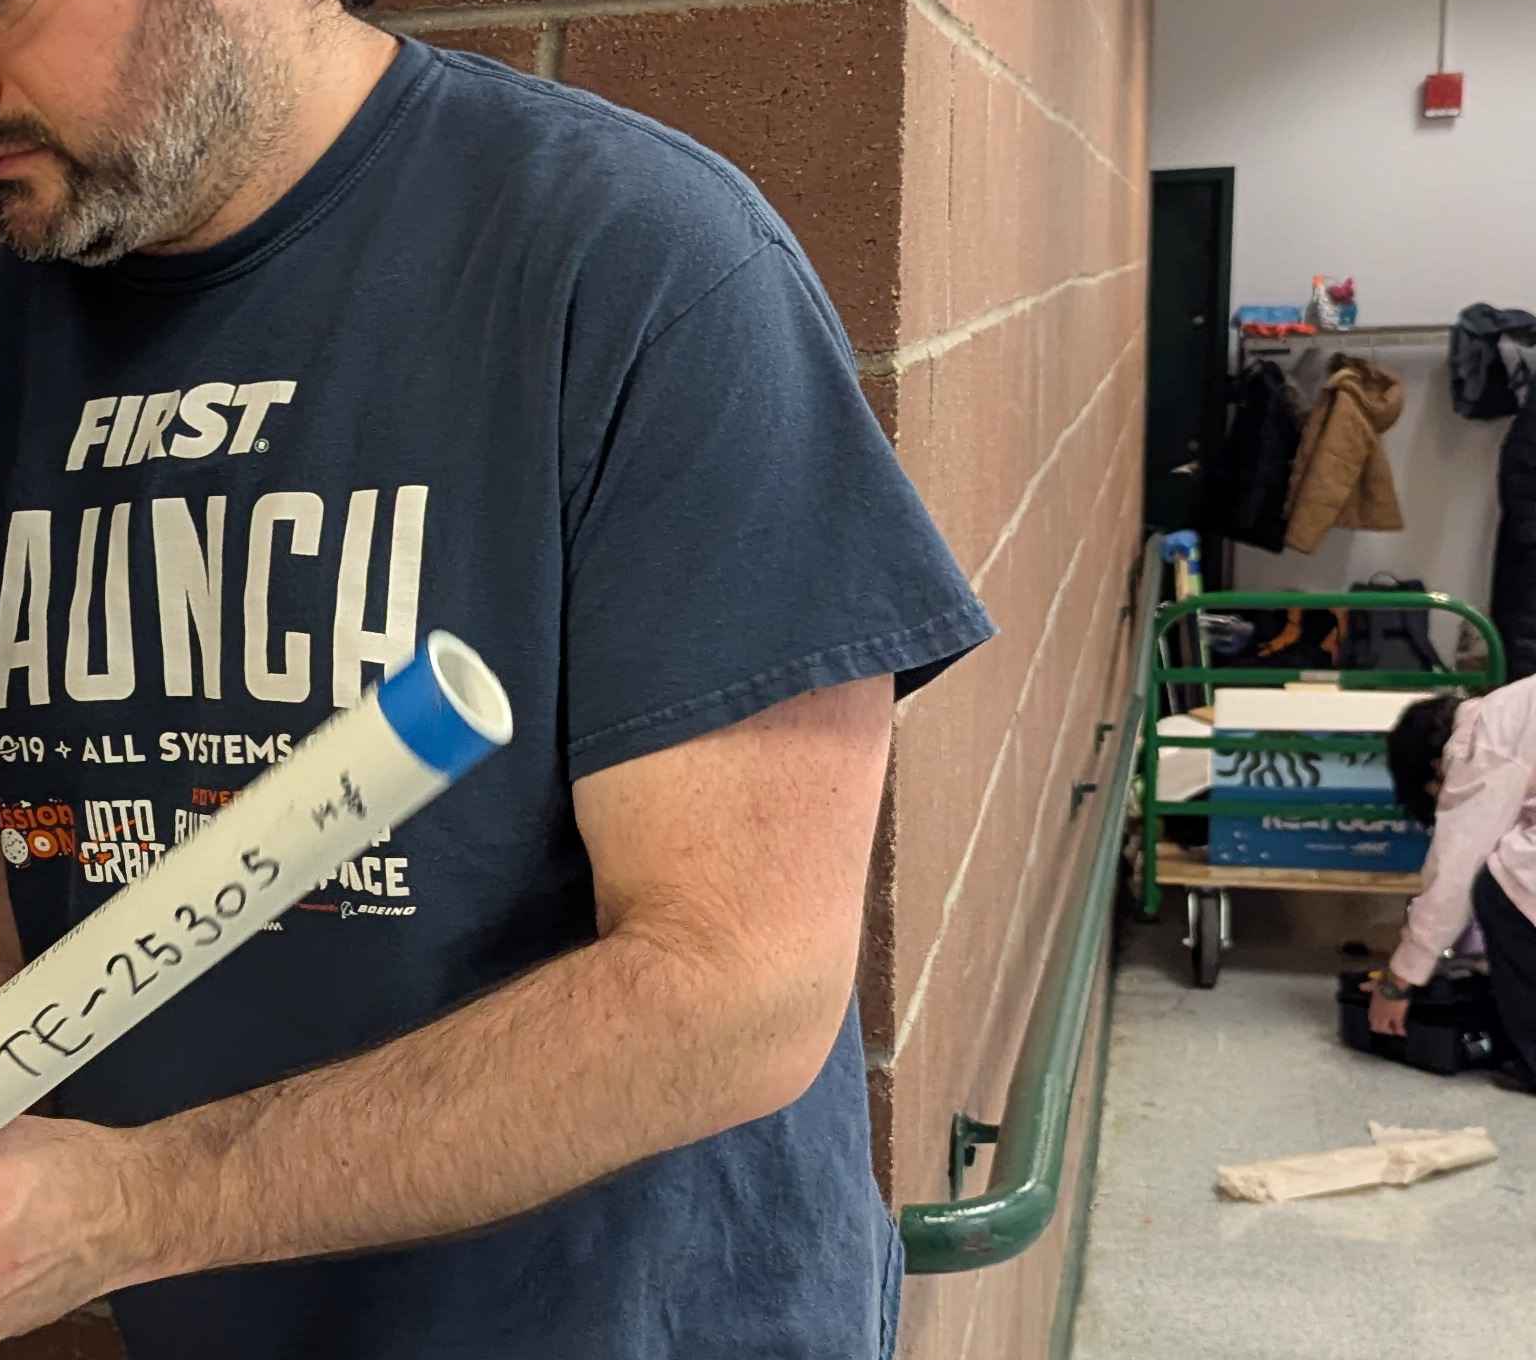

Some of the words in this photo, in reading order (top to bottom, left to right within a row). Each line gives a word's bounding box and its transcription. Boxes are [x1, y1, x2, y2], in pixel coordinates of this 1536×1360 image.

[80, 732, 147, 765] ALL
[158, 730, 296, 766] SYSTEMS
[83, 798, 157, 843] INTO
[356, 903, 417, 917] BOEING
